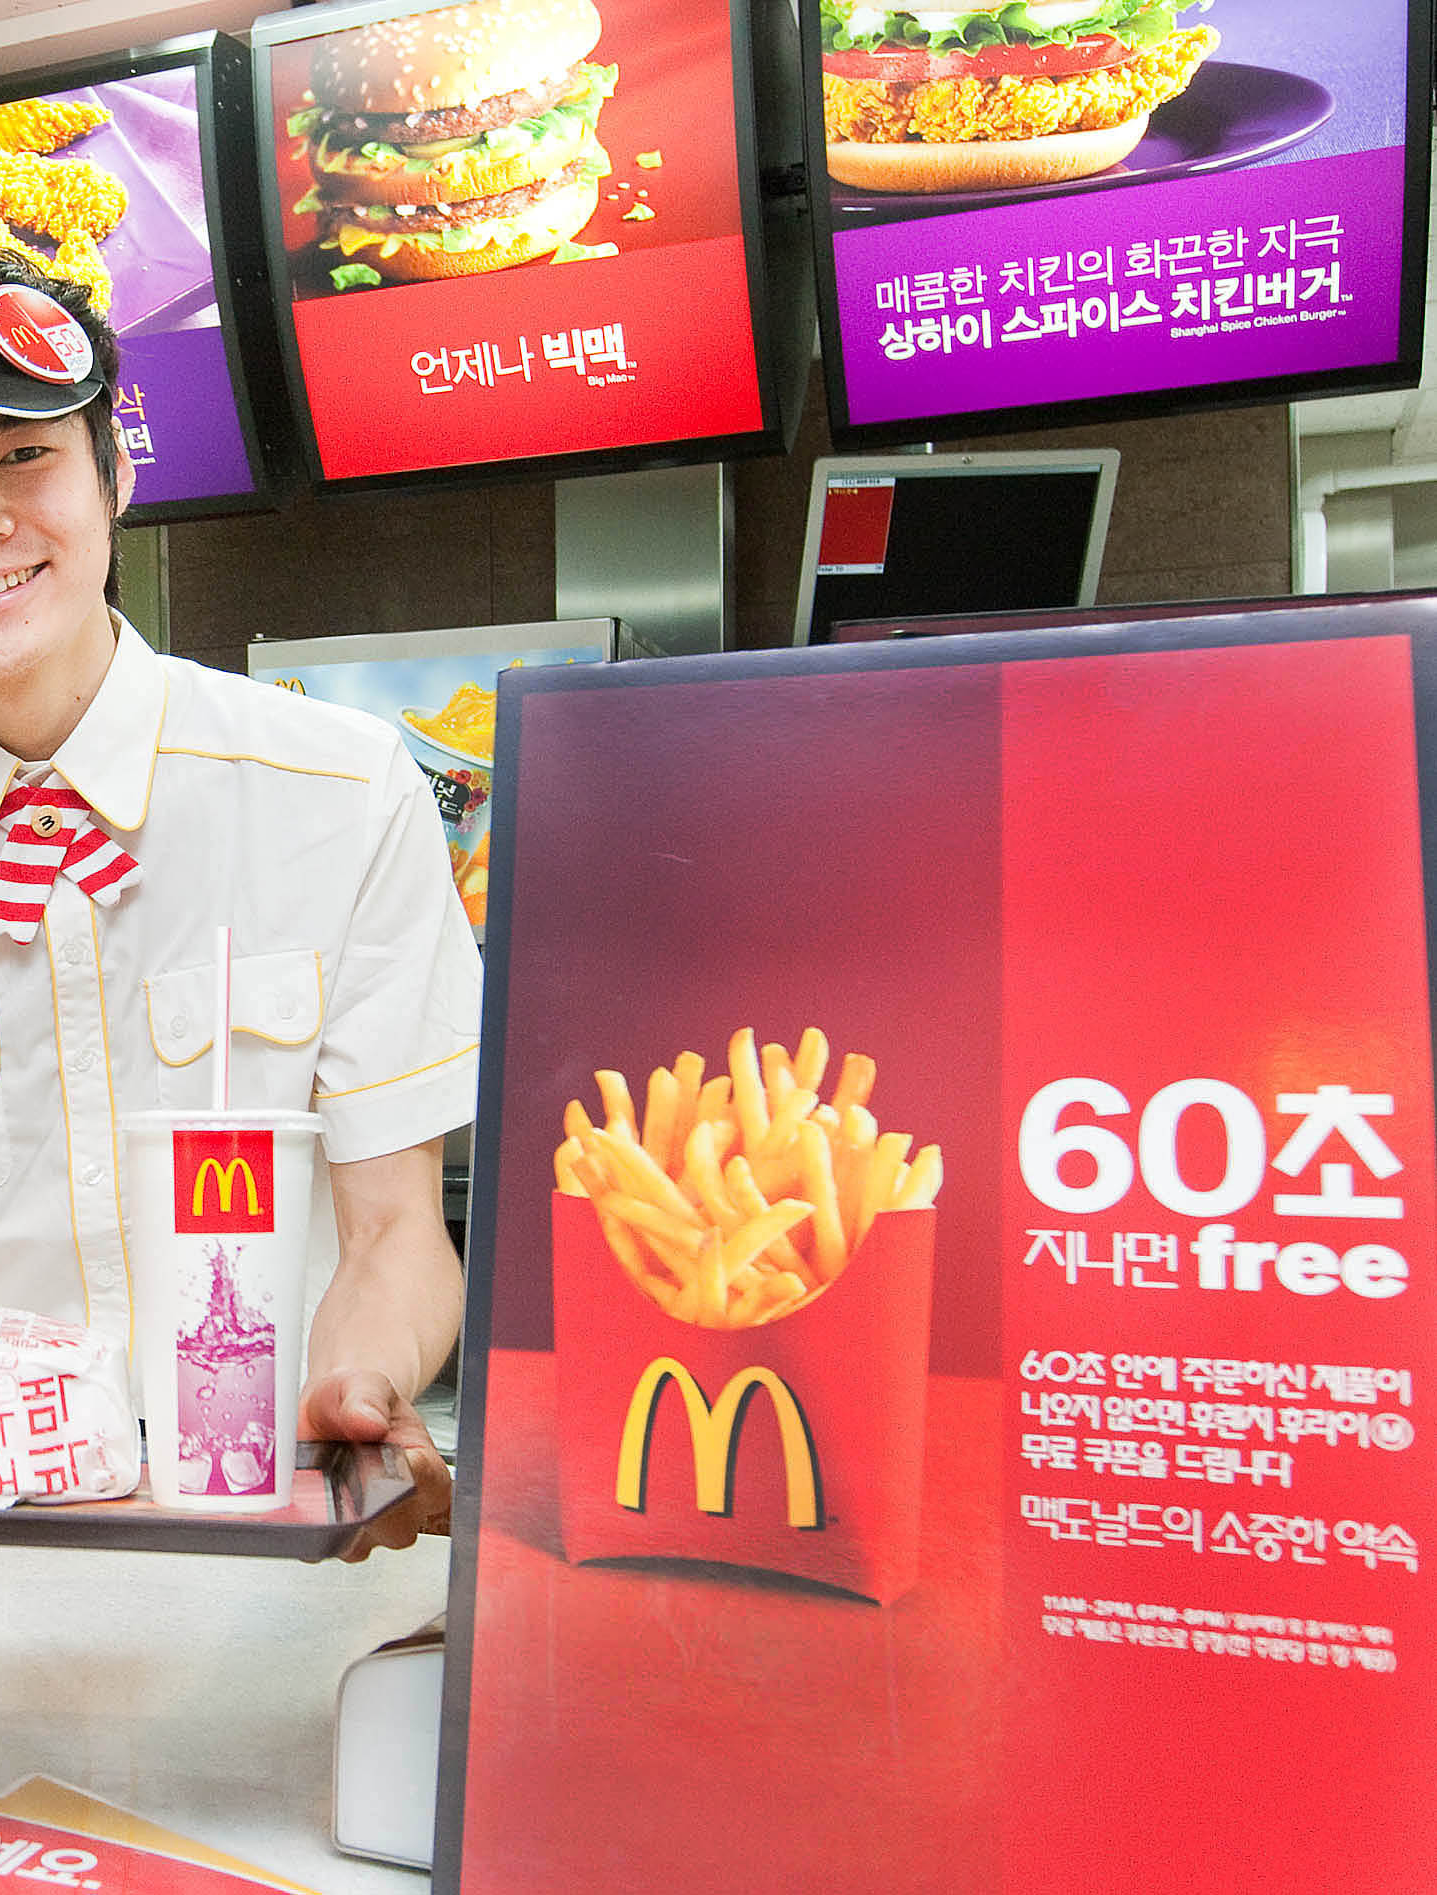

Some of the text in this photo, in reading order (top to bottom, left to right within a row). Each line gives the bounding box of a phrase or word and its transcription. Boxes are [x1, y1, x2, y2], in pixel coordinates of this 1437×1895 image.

[876, 214, 1344, 313] 매콤한 치킨의 화끈한 자극
[878, 310, 992, 360] 상하이
[1000, 293, 1163, 343] 스파이스
[1170, 323, 1218, 339] Shanghai
[1220, 320, 1251, 333] Spice
[1253, 314, 1298, 328] Chicken
[411, 336, 534, 394] 언제나
[586, 374, 606, 387] Big
[1019, 1077, 1404, 1219] 60초
[1023, 1223, 1409, 1298] 지나면 free
[1020, 1350, 1412, 1407] 60초 안에 주문하신 제품이
[1021, 1391, 1101, 1430] 나오지
[1103, 1396, 1186, 1436] 않으면
[1020, 1433, 1295, 1488] 무료 쿠폰을 드립니다
[1020, 1495, 1419, 1573] 맥도날드의 소중한 약속
